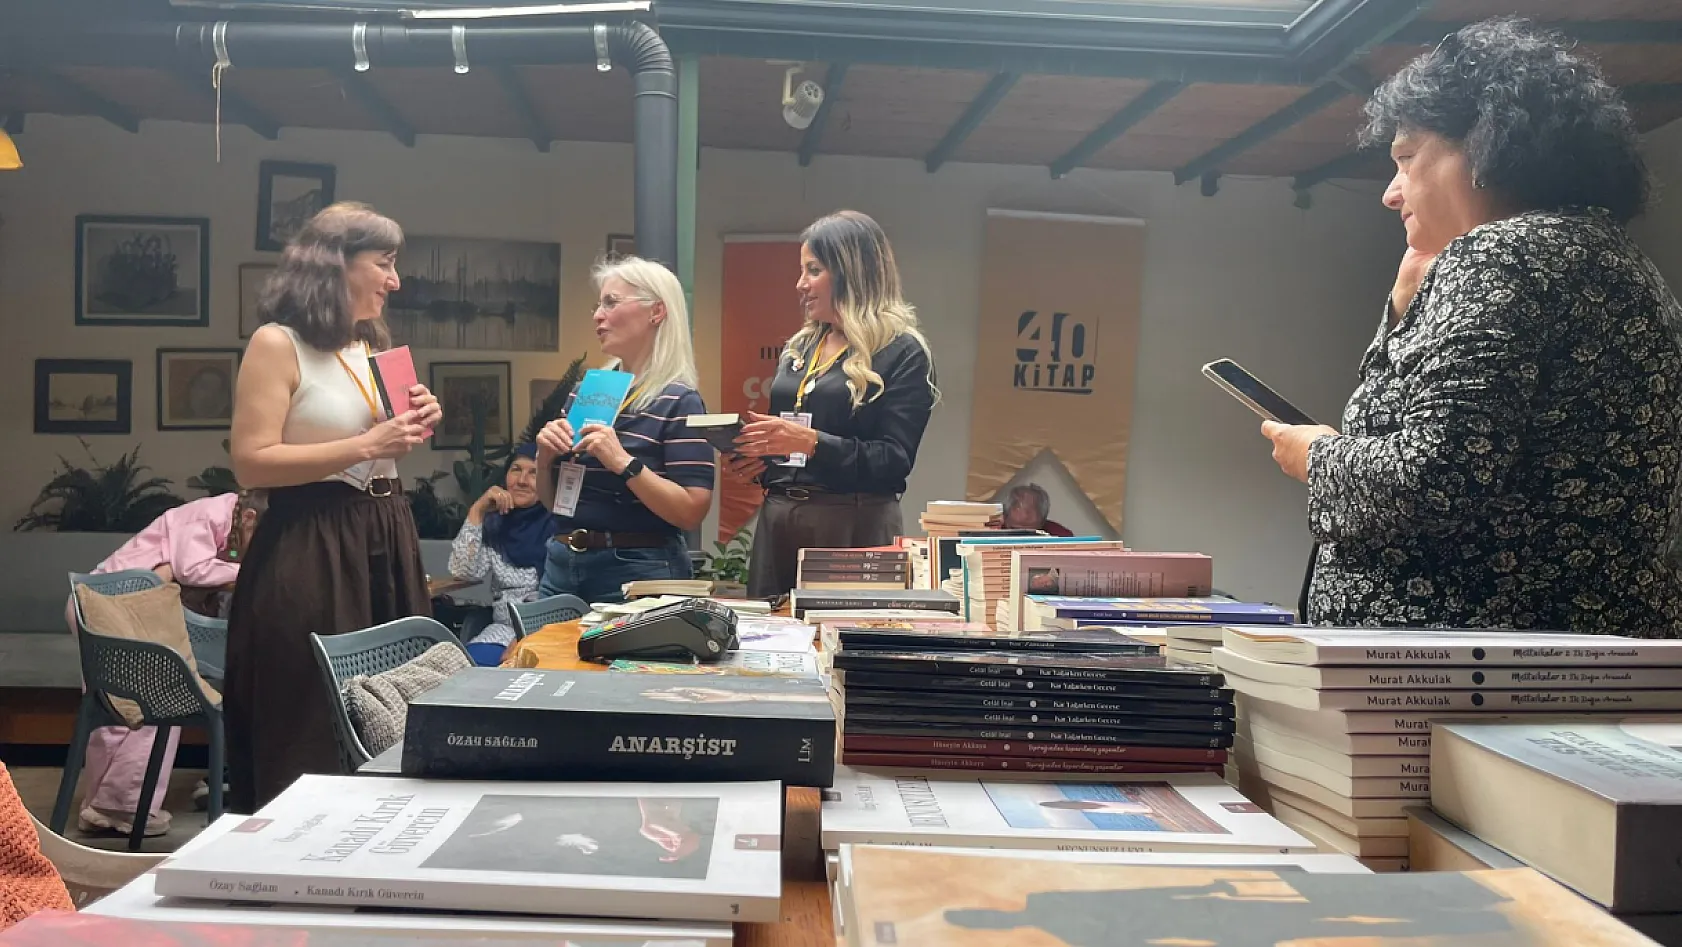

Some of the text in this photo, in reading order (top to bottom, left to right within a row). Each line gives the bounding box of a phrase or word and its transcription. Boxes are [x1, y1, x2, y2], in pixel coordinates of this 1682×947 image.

[1366, 649, 1401, 660] Murat
[1405, 649, 1451, 660] Akkulak
[1369, 674, 1403, 685] Murat
[1407, 674, 1451, 685] Akkulak
[1367, 696, 1402, 706] Murat
[1405, 696, 1450, 706] Akkulak
[1394, 719, 1428, 730] Murat
[447, 732, 539, 748] ÖZAY SAĞLAM
[608, 734, 737, 760] ANARŞİST
[1401, 764, 1430, 774] Mura
[1400, 782, 1429, 792] Mura
[300, 794, 415, 862] Kanadı Kırık
[369, 808, 450, 854] Güvercin
[209, 879, 425, 901] Özay Sağlam Kanadı Kırık Güvercin
